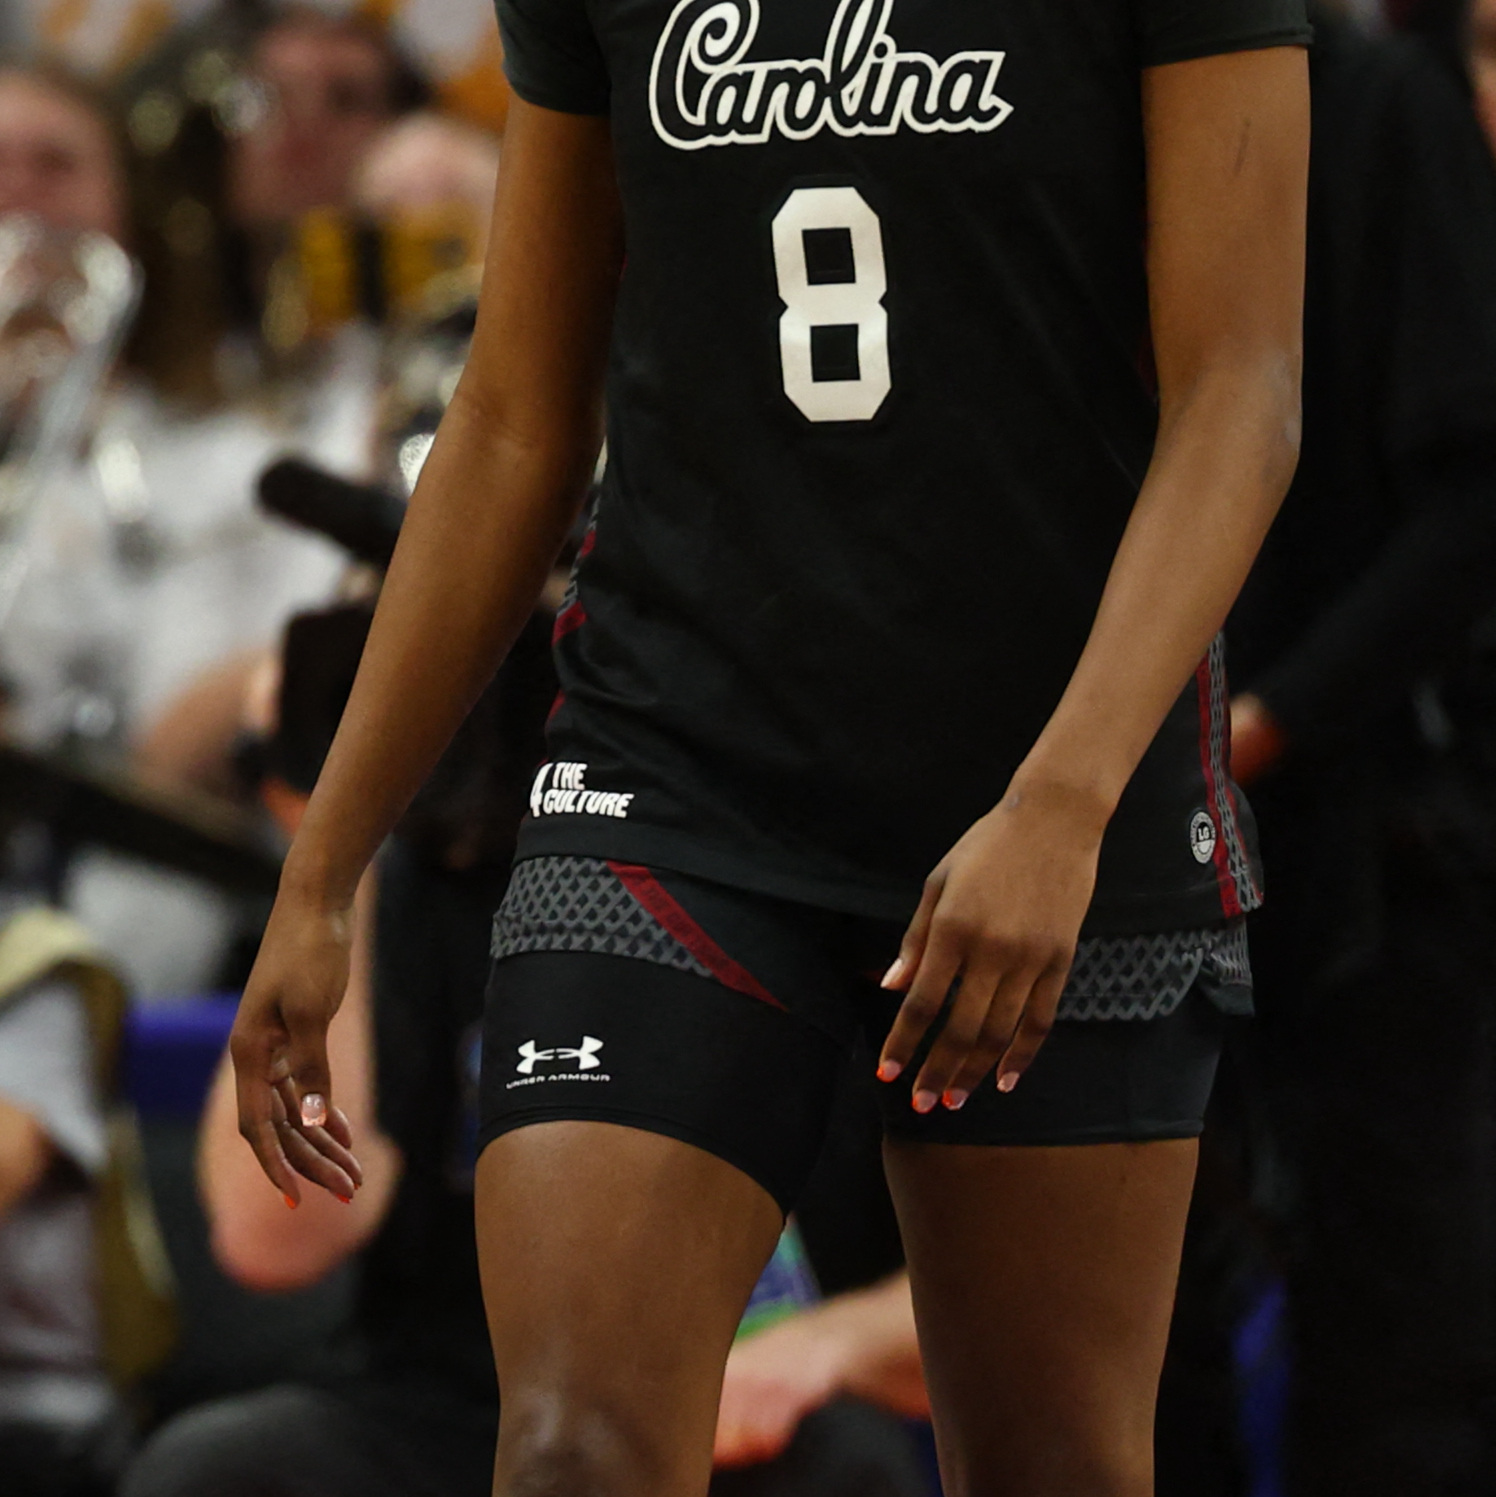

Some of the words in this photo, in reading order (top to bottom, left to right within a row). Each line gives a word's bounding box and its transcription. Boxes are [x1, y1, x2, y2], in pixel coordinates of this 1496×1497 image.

[771, 186, 892, 422] 8
[552, 761, 588, 791] THE
[542, 788, 635, 819] CULTURE
[547, 1072, 611, 1082] ARMOUR
